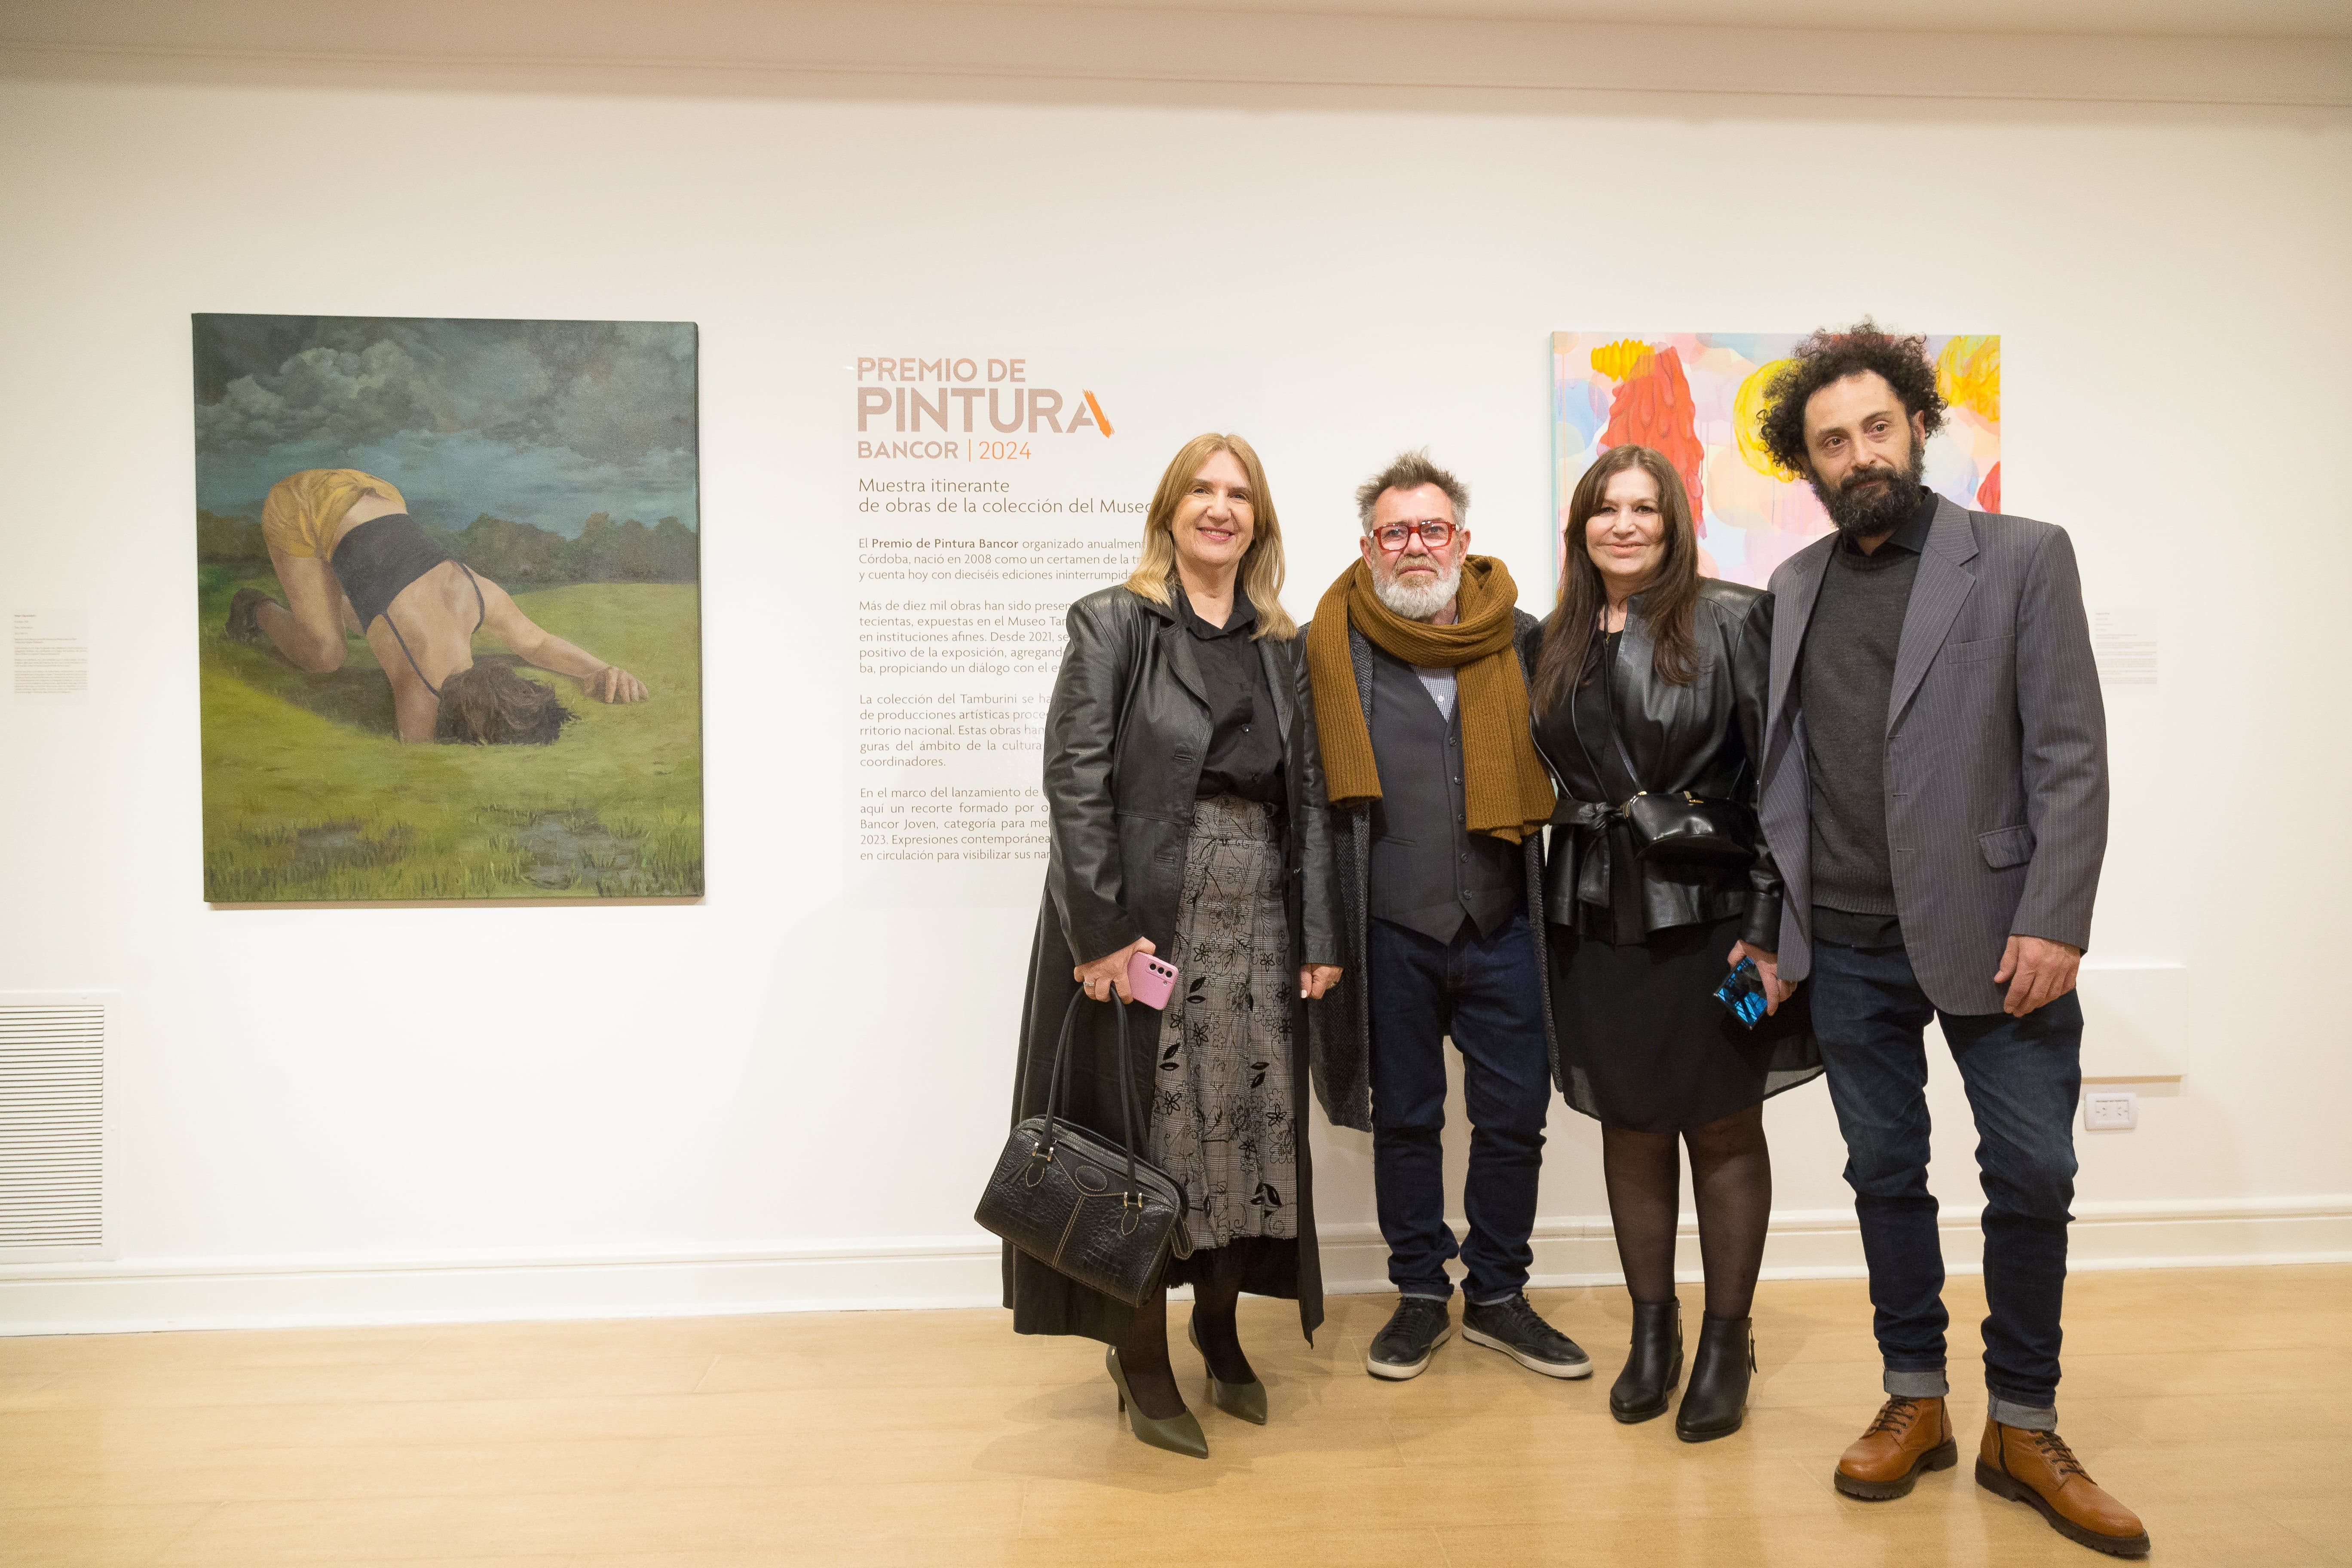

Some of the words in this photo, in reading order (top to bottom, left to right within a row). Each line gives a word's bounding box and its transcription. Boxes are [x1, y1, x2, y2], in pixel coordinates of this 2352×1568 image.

[857, 357, 978, 383] PREMIO
[987, 358, 1026, 383] DE
[857, 387, 1115, 438] PINTURA
[858, 441, 959, 459] BANCOR
[979, 441, 1032, 460] 2024
[859, 478, 926, 493] Muestra
[931, 478, 1010, 493] itinerante
[859, 496, 879, 513] de
[885, 496, 931, 513] obras
[937, 497, 958, 513] de
[964, 497, 977, 513] la
[982, 497, 1063, 513] colección
[1068, 497, 1094, 513] del
[1100, 499, 1152, 513] Museo
[859, 537, 868, 548] El
[872, 538, 913, 548] Premio
[916, 537, 931, 548] de
[934, 538, 976, 549] Pintura
[979, 538, 1019, 549] Bancor
[1022, 538, 1084, 552] organizado
[1087, 538, 1144, 549] anualmen
[859, 553, 911, 565] Córdoba,
[914, 554, 944, 564] nació
[964, 554, 992, 564] 2008
[995, 556, 1027, 564] como
[1047, 555, 1100, 564] certamen
[1102, 553, 1117, 564] de
[1120, 553, 1129, 564] la
[859, 572, 865, 582] y
[868, 570, 905, 580] cuenta
[908, 568, 928, 582] hoy
[931, 572, 952, 580] con
[954, 568, 999, 580] dieciséis
[1002, 568, 1053, 580] ediciones
[1056, 568, 1132, 582] ininterrumpid
[859, 600, 882, 611] Más
[885, 600, 900, 611] de
[903, 600, 926, 611] diez
[930, 600, 947, 611] mil
[950, 600, 981, 611] obras
[984, 600, 1004, 611] han
[1008, 600, 1032, 611] sido
[859, 617, 914, 627] tecientas,
[917, 617, 974, 629] expuestas
[994, 615, 1004, 626] el
[1008, 616, 1046, 626] Museo
[859, 634, 873, 642] en
[876, 632, 949, 642] instituciones
[952, 631, 987, 642] afines.
[990, 631, 1026, 642] Desde
[1029, 631, 1054, 643] 2021,
[1057, 634, 1069, 642] se
[859, 647, 906, 661] positivo
[910, 646, 925, 658] de
[928, 646, 938, 657] la
[941, 646, 1007, 660] exposición,
[1011, 646, 1065, 661] agregand
[860, 662, 876, 674] ba,
[879, 662, 947, 676] propiciando
[951, 665, 965, 673] un
[968, 662, 1010, 676] diálogo
[1038, 662, 1047, 673] el
[860, 694, 872, 704] La
[877, 693, 933, 704] colección
[937, 693, 956, 704] del
[960, 693, 1017, 704] Tamburini
[860, 709, 874, 720] de
[877, 708, 956, 723] producciones
[959, 709, 1010, 720] artísticas
[1013, 711, 1048, 723] proce
[860, 726, 901, 736] rritorio
[904, 724, 955, 735] nacional.
[959, 725, 987, 735] Estas
[989, 724, 1021, 735] obras
[1024, 724, 1044, 735] han
[860, 743, 890, 754] guras
[895, 740, 913, 751] del
[919, 740, 961, 751] ámbito
[966, 739, 981, 751] de
[987, 739, 996, 750] la
[1002, 739, 1042, 750] cultura
[860, 755, 946, 767] coordinadores.
[861, 788, 873, 798] En
[877, 787, 887, 798] el
[930, 786, 948, 798] del
[952, 786, 1021, 797] lanzamiento
[1024, 786, 1039, 797] de
[860, 803, 884, 817] aquí
[890, 805, 904, 814] un
[911, 804, 952, 813] recorte
[959, 802, 1008, 813] formado
[1015, 805, 1035, 816] por
[861, 819, 900, 829] Bancor
[903, 819, 939, 830] Joven,
[944, 818, 996, 832] categoría
[1001, 820, 1025, 831] para
[861, 834, 888, 845] 2023.
[892, 834, 958, 848] Expresiones
[876, 849, 934, 861] circulación
[937, 852, 959, 863] para
[963, 848, 1011, 860] visibilizar
